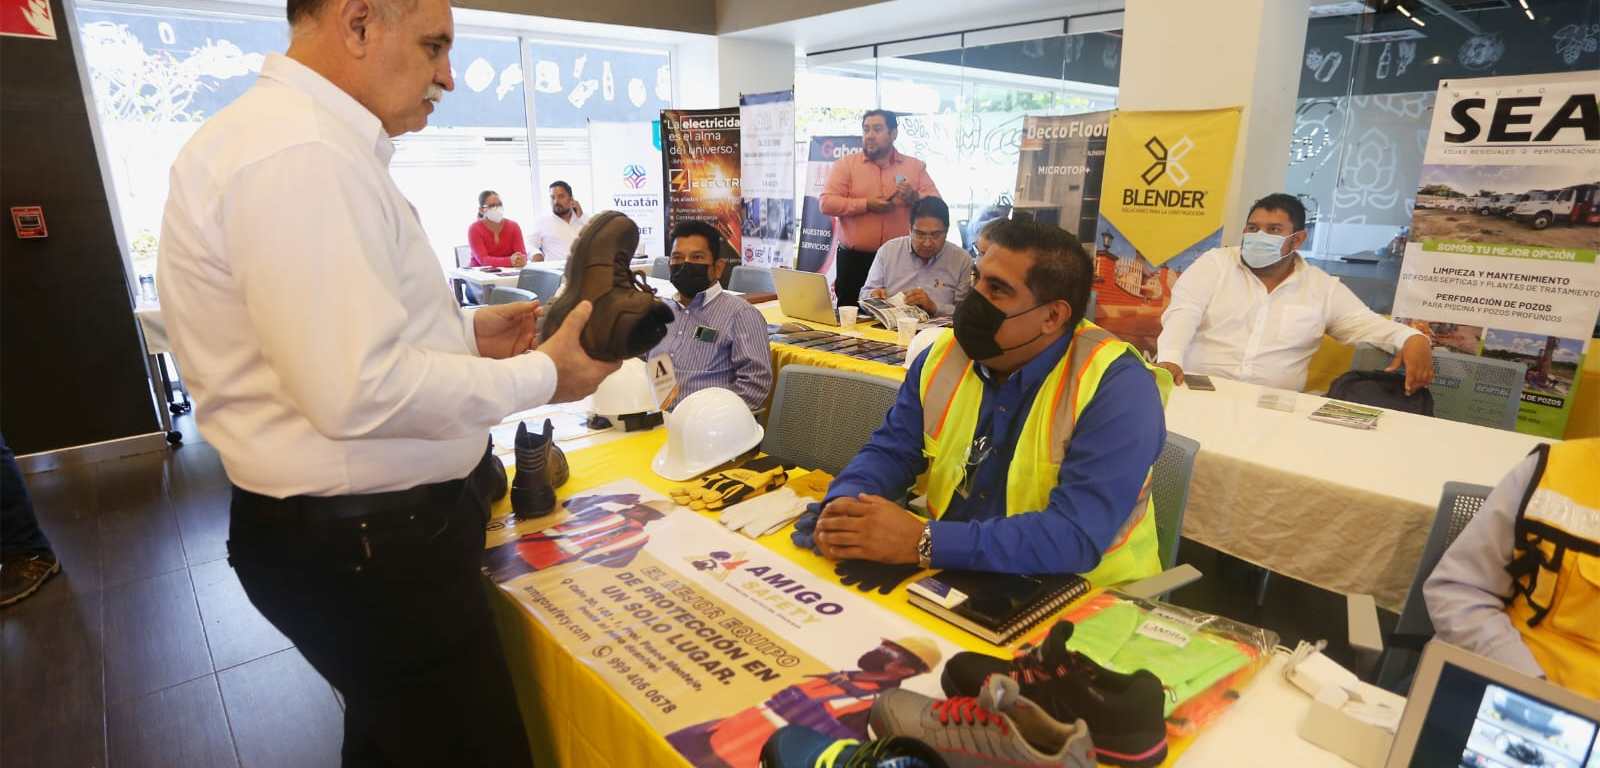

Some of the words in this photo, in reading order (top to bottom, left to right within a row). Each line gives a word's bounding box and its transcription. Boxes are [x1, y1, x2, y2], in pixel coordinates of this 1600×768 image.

[1444, 94, 1600, 143] SEA
[695, 131, 721, 141] alma
[613, 197, 658, 207] Yucatán
[1122, 188, 1204, 208] BLENDER
[802, 228, 831, 238] NUESTROS
[801, 242, 830, 252] SERVICIOS
[1438, 243, 1474, 253] SOMOS
[1477, 246, 1490, 254] TU
[1492, 247, 1530, 257] MEJOR
[1433, 267, 1475, 277] LIMPIEZA
[1486, 272, 1570, 286] MANTENIMIENTO
[1486, 281, 1525, 291] PLANTAS
[1526, 284, 1538, 292] DE
[1422, 300, 1442, 309] PARA
[1444, 302, 1475, 312] PISCINA
[1512, 310, 1562, 322] PROFUNDOS
[1436, 292, 1502, 306] PERFORACIÓN
[1504, 300, 1517, 309] DE
[1518, 302, 1552, 312] POZOS
[744, 566, 844, 615] AMIGO
[742, 581, 821, 624] SAFETY
[601, 585, 631, 603] UN
[623, 602, 673, 634] SOLO
[665, 633, 736, 686] LUGAR.
[616, 571, 644, 587] DE
[637, 586, 750, 661] PROTECCIÓN
[742, 660, 781, 683] EN
[719, 616, 801, 668] EQUIPO
[607, 656, 631, 674] 999
[644, 689, 677, 715] 0678
